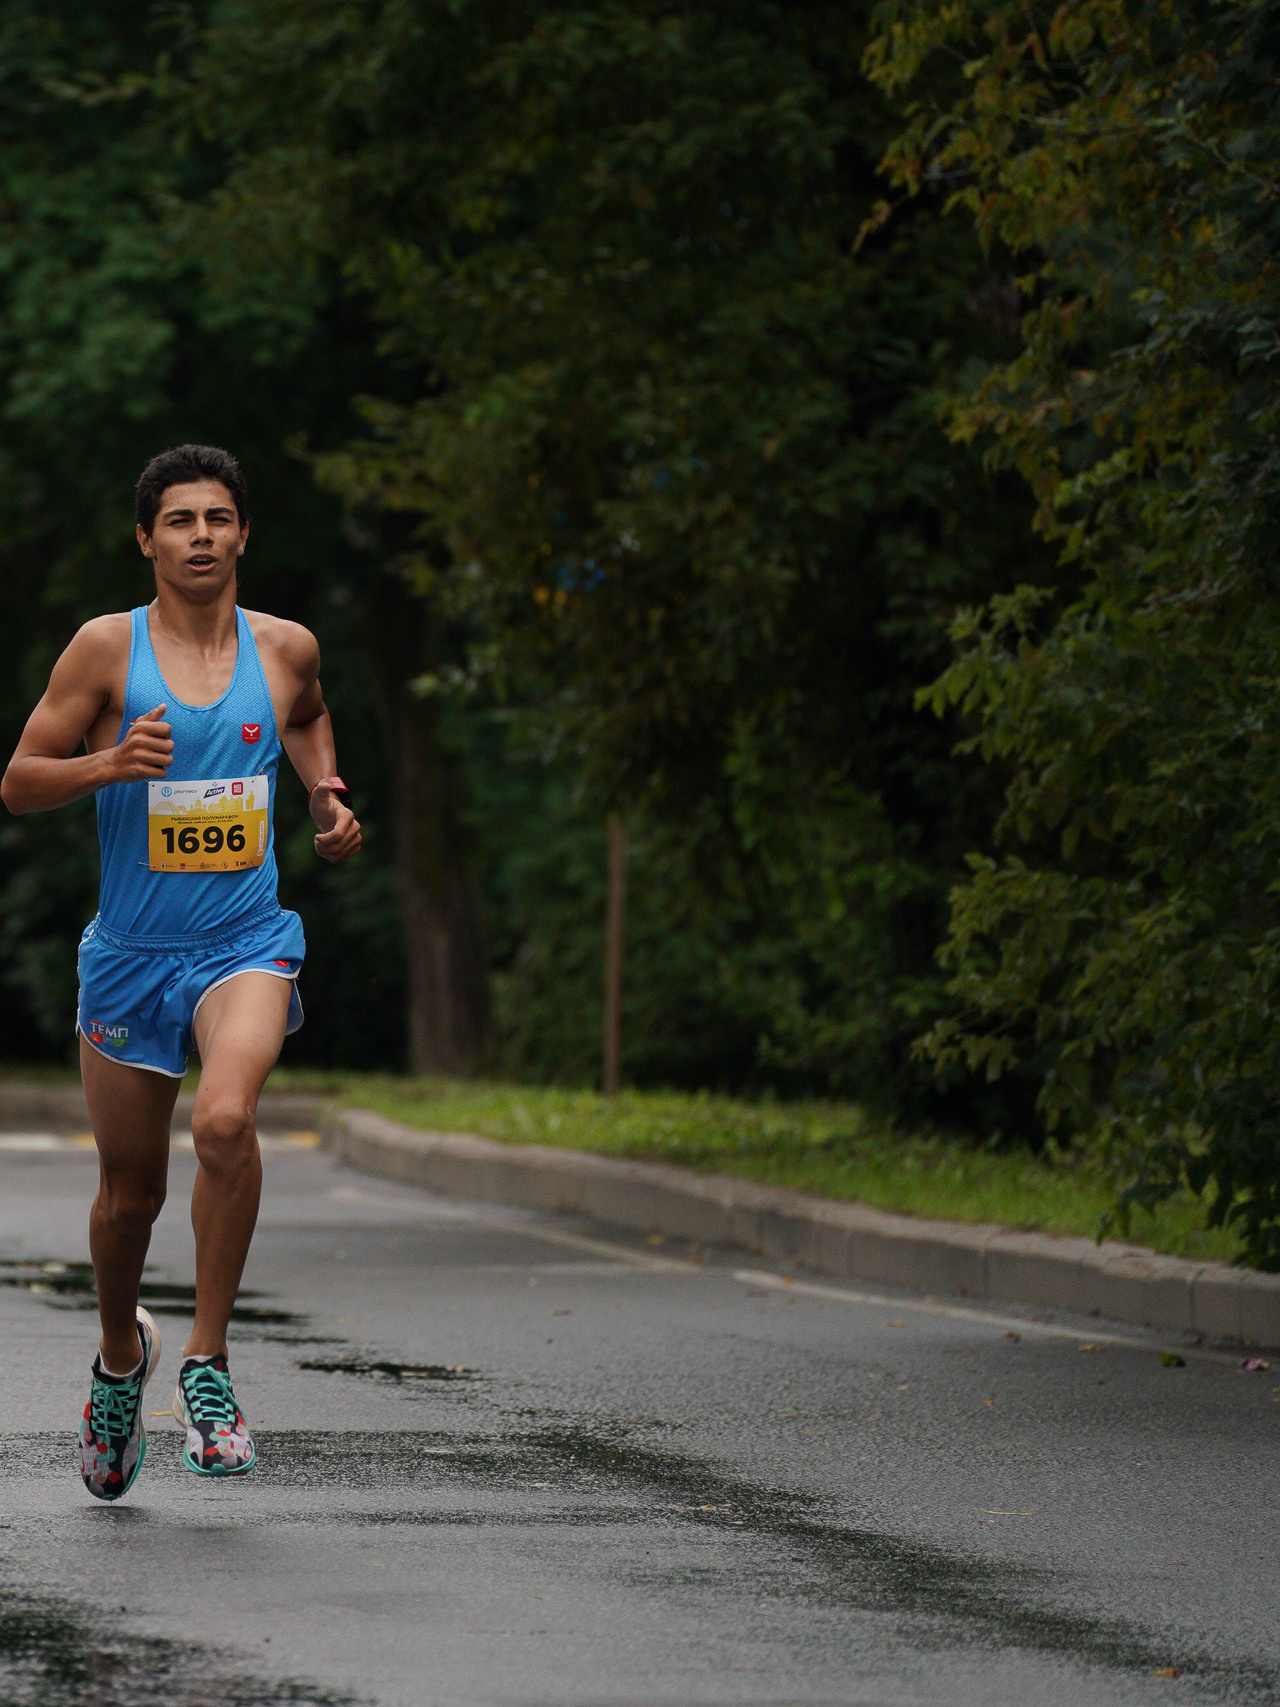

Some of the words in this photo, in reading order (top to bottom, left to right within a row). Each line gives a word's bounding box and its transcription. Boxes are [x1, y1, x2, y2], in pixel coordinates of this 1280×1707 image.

[206, 787, 224, 796] Active
[161, 824, 246, 854] 1696
[89, 1021, 129, 1038] ТЕМП
